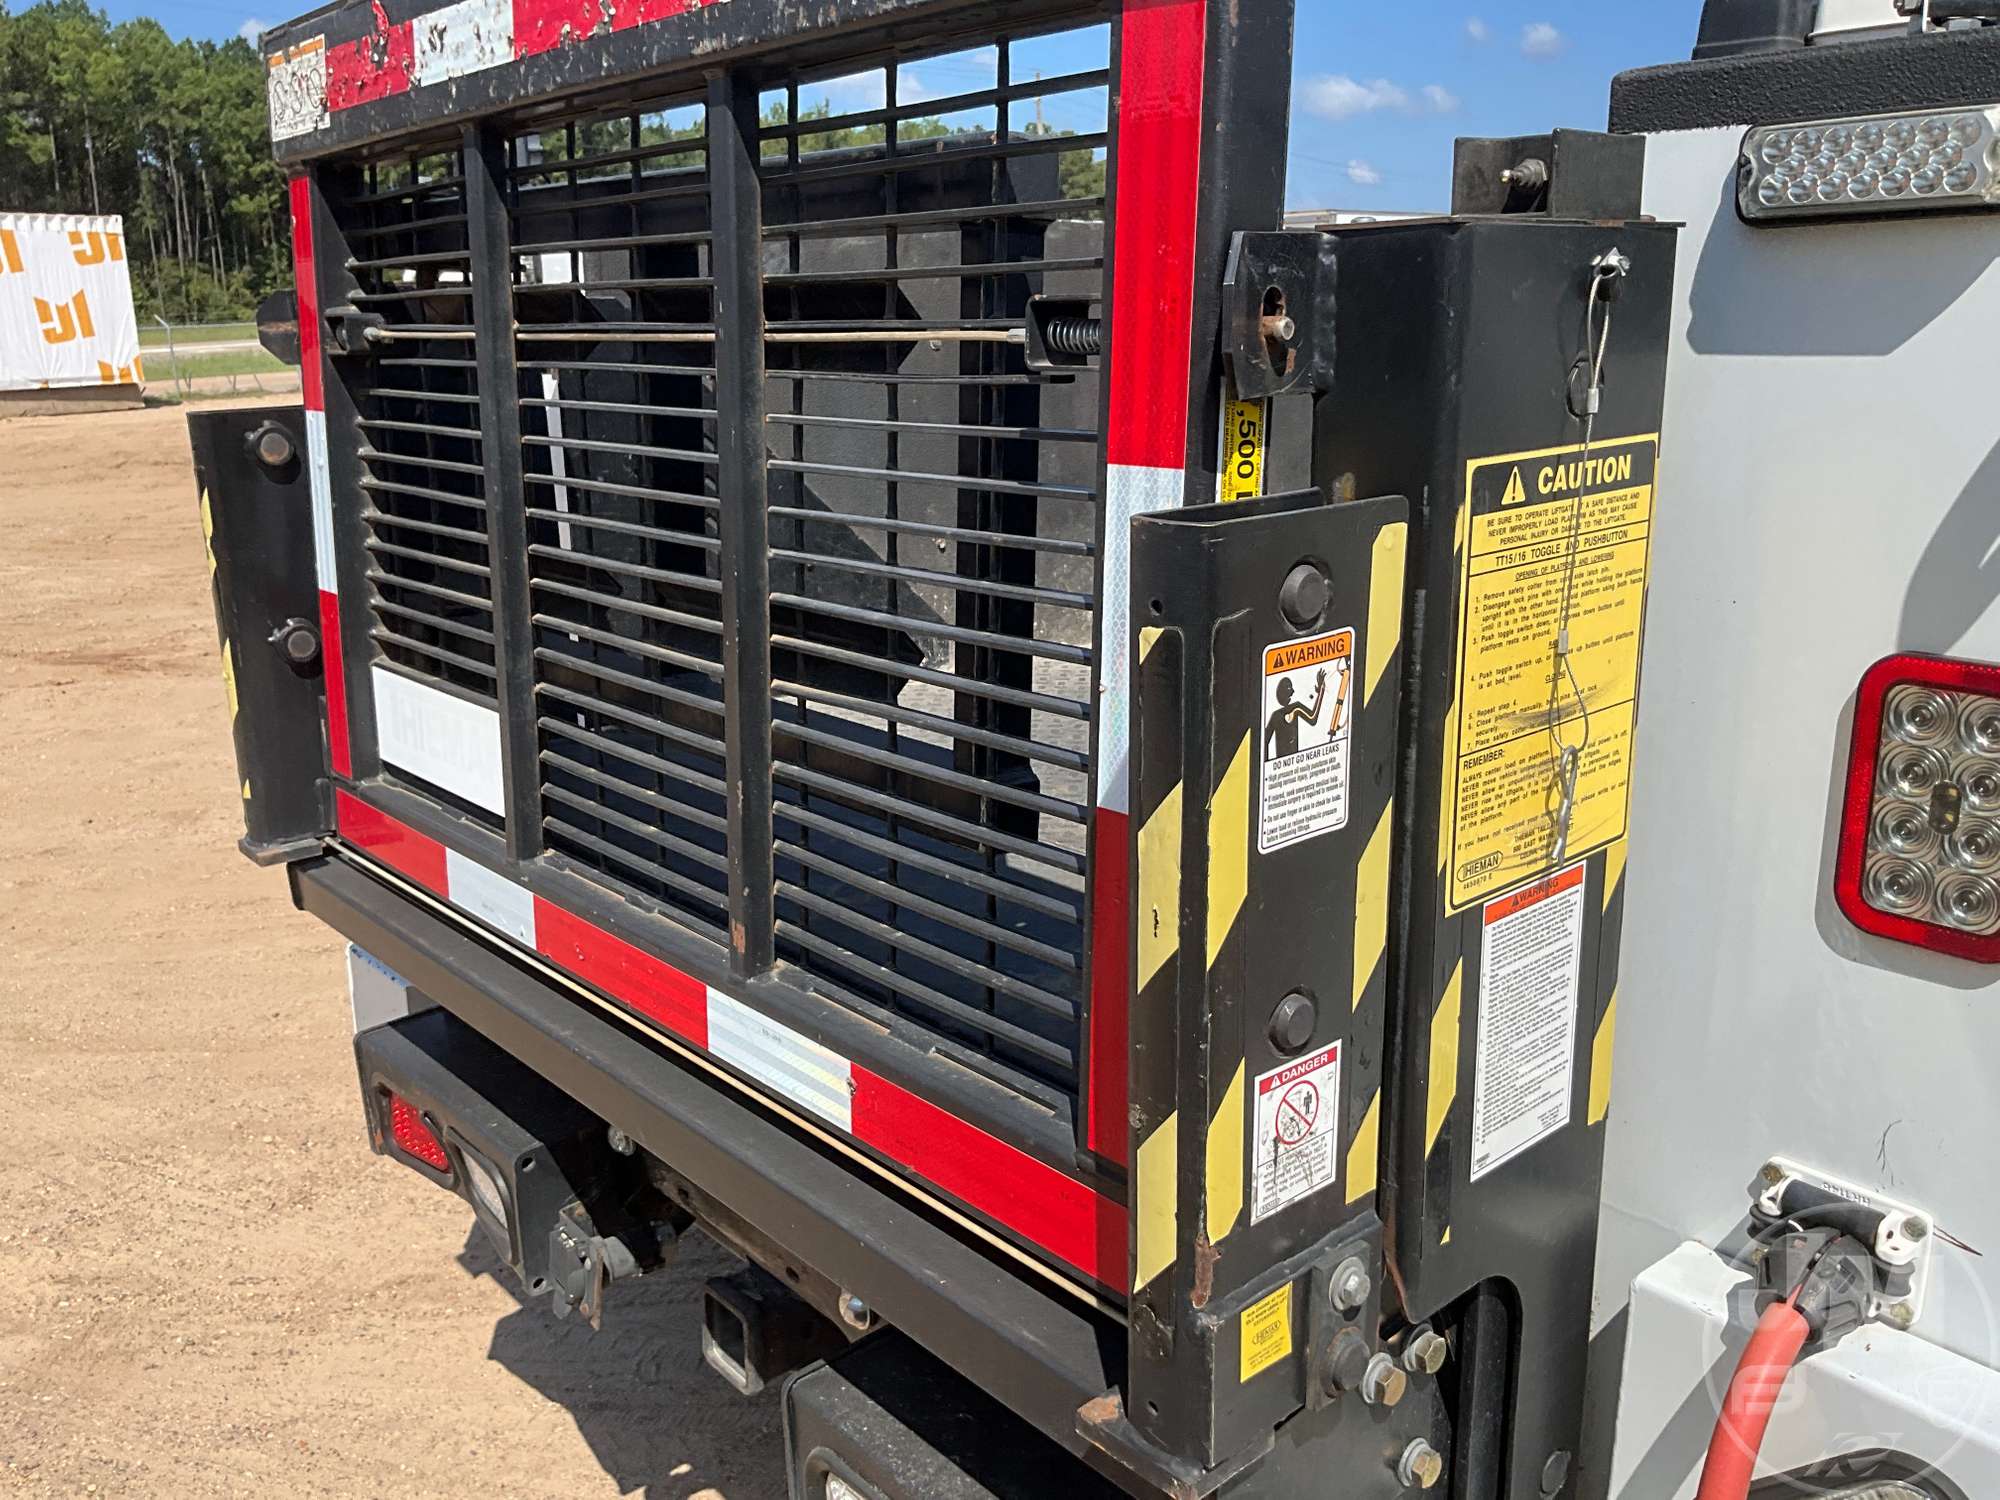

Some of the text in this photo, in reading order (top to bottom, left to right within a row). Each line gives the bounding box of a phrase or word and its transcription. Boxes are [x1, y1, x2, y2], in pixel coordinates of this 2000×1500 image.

[1233, 409, 1257, 479] ,500
[1537, 453, 1630, 495] CAUTION
[1487, 518, 1494, 526] BE
[1497, 515, 1511, 524] SURE
[1515, 513, 1521, 521] TO
[1525, 508, 1548, 519] OPERATE
[1592, 498, 1603, 506] SAFE
[1606, 494, 1627, 504] DISTANCE
[1488, 527, 1506, 537] NEVER
[1509, 520, 1541, 533] IMPROPERLY
[1544, 517, 1558, 526] LOAD
[1597, 507, 1607, 515] THIS
[1622, 502, 1636, 510] CAUSE
[1500, 533, 1526, 545] PERSONAL
[1530, 529, 1548, 539] INJURY
[1584, 520, 1590, 528] TO
[1495, 528, 1628, 566] TT15/16 TOGGLE AND PUSHBUTTON
[1515, 568, 1537, 580] OPENING
[1540, 566, 1547, 574] OF
[1590, 551, 1614, 562] LOWERING
[1483, 590, 1504, 601] Remove
[1508, 585, 1523, 596] safety
[1527, 581, 1541, 590] cotter
[1482, 598, 1510, 612] Disengage
[1482, 610, 1506, 622] upright
[1481, 632, 1494, 642] Push
[1497, 628, 1513, 639] toggle
[1516, 623, 1533, 632] switch
[1286, 637, 1344, 664] WARNING
[1480, 640, 1502, 653] platform
[1479, 670, 1492, 680] Push
[1495, 665, 1512, 676] toggle
[1515, 659, 1531, 669] switch
[1477, 701, 1509, 717] Repeat step
[1476, 717, 1491, 726] Close
[1475, 730, 1509, 747] Place safety
[1273, 743, 1339, 770] DO NOT GO NEAR LEAKS
[1463, 748, 1504, 770] REMEMBER:
[1462, 772, 1481, 784] ALWAYS
[1485, 765, 1501, 776] center
[1504, 761, 1515, 770] load
[1462, 782, 1479, 794] NEVER
[1482, 776, 1496, 786] move
[1461, 791, 1478, 802] NEVER
[1461, 800, 1478, 812] NEVER
[1460, 810, 1477, 822] NEVER
[1519, 876, 1558, 903] WARNING
[1282, 1052, 1327, 1082] DANGER
